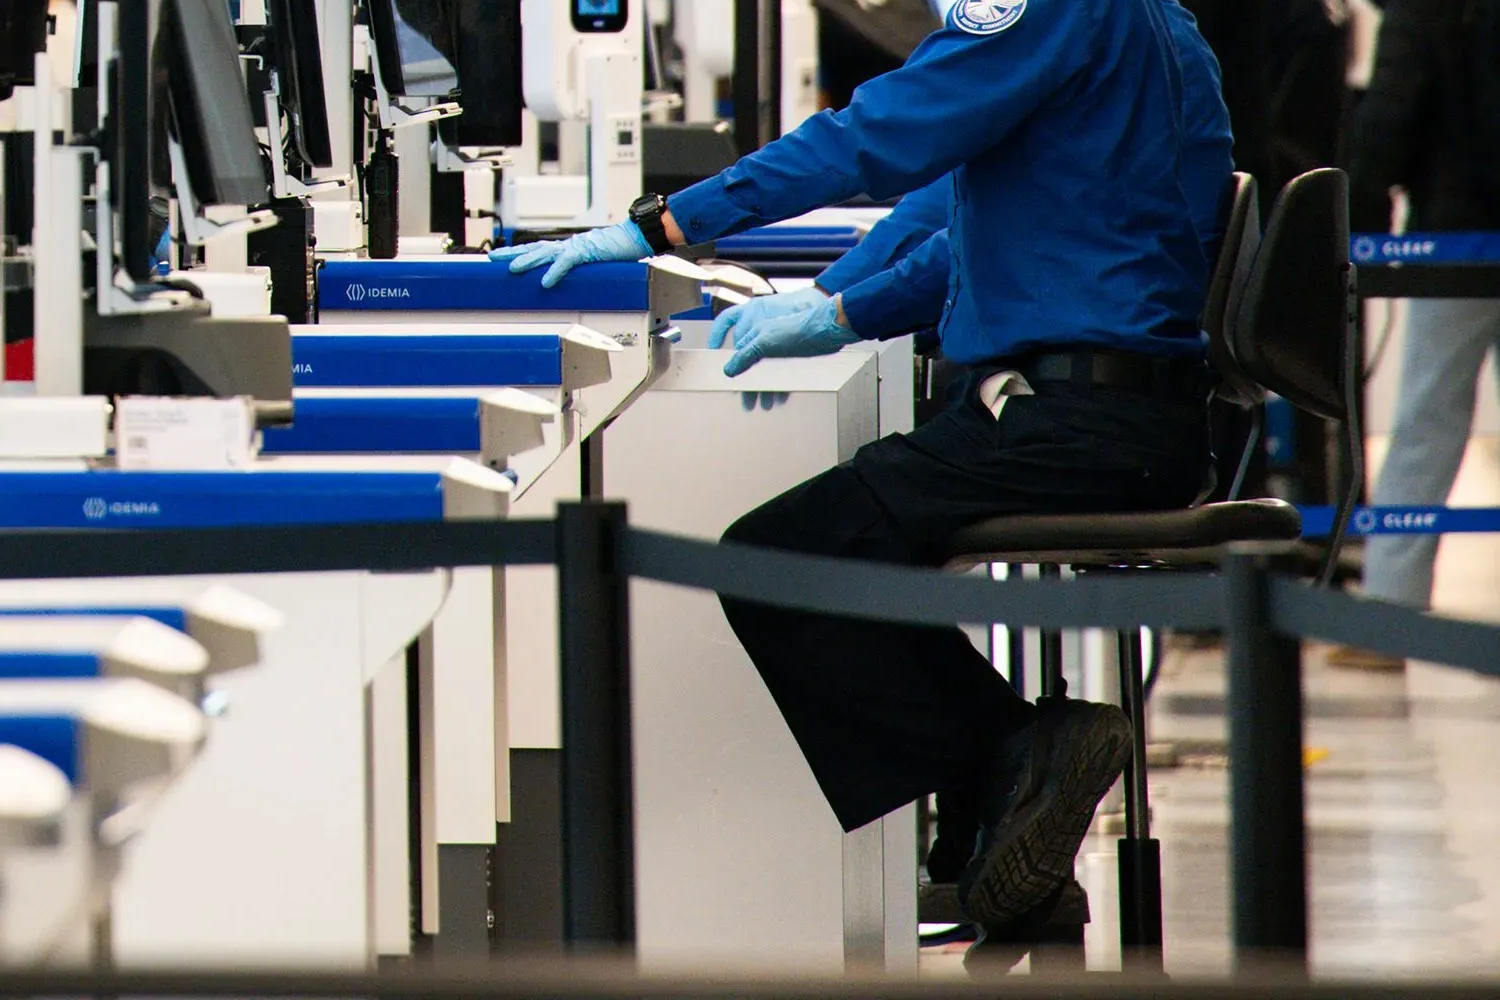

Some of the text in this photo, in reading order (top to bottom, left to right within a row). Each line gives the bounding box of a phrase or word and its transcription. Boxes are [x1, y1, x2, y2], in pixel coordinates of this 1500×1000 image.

[368, 288, 410, 298] IDEMIA
[291, 364, 313, 374] MIA
[108, 502, 160, 514] IDEMIA
